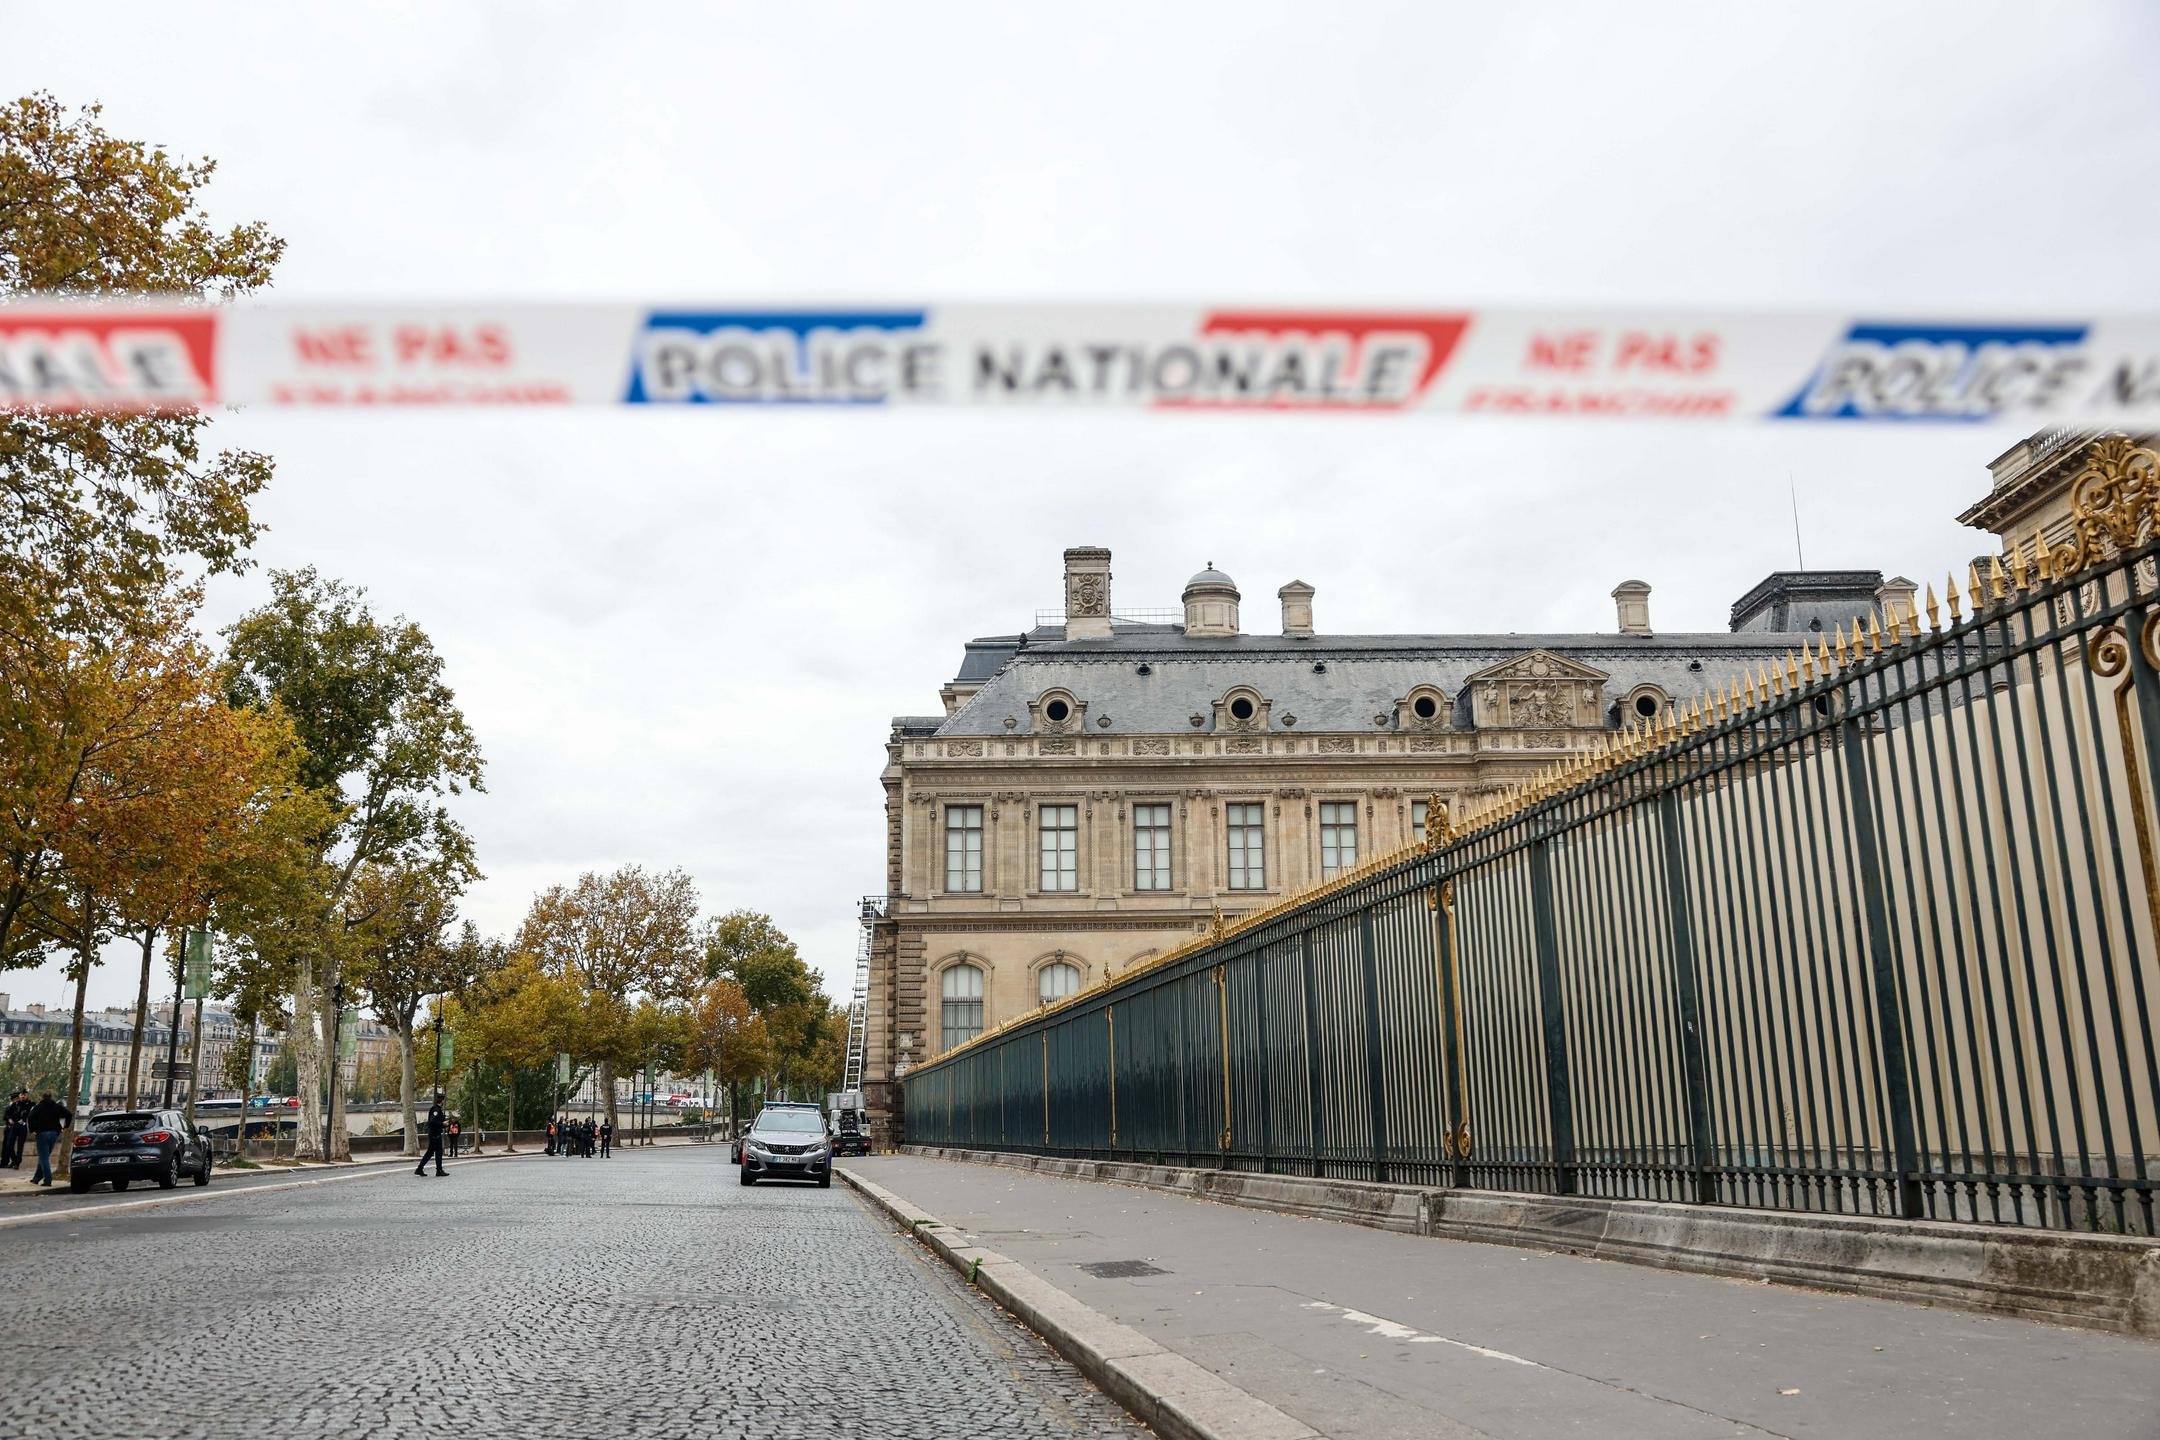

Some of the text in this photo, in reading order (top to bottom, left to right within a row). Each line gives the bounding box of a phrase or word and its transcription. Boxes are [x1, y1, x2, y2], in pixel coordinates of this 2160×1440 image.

[290, 323, 514, 368] NE PAS
[653, 342, 1415, 395] POLICE NATIONALE
[1523, 328, 1722, 375] NE PAS
[1816, 354, 2088, 407] POLICE
